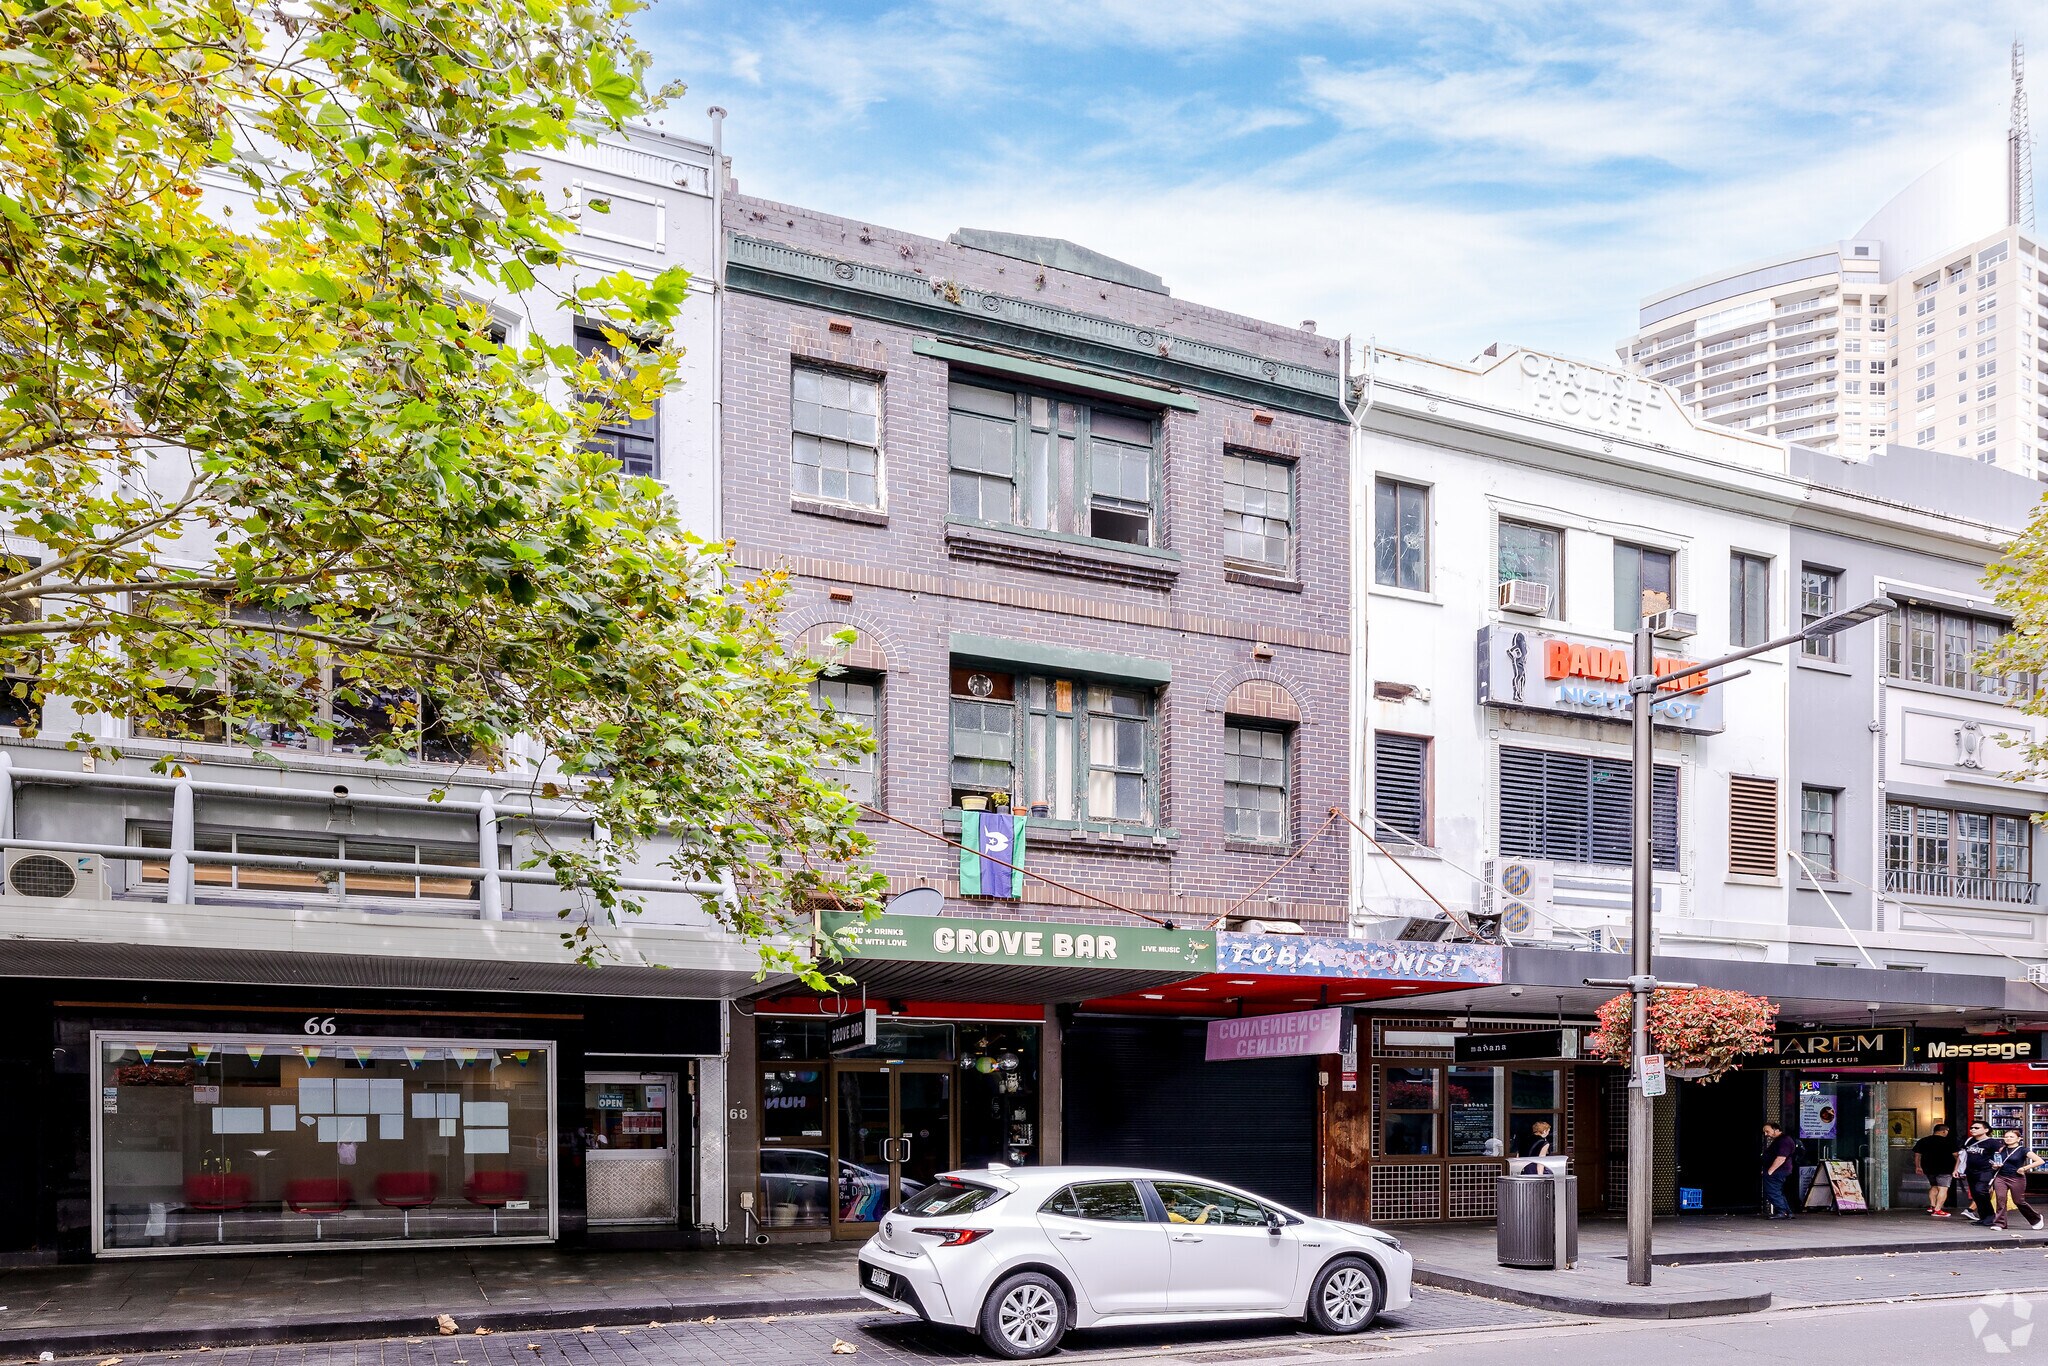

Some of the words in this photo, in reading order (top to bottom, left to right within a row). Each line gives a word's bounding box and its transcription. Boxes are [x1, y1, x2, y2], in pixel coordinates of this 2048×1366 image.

[1520, 354, 1662, 410] CARLISLE
[1544, 639, 1629, 683] BADA
[874, 928, 904, 936] DRINKS
[864, 938, 885, 946] WITH
[887, 939, 908, 947] LOVE
[933, 927, 1044, 956] GROVE
[1052, 933, 1118, 960] BAR
[304, 1016, 337, 1035] 66
[832, 1025, 850, 1044] GROVE
[851, 1021, 863, 1038] BAR
[1928, 1041, 2032, 1060] Massage
[1780, 1057, 1834, 1065] GENTLEMENS
[599, 1098, 623, 1108] OPEN
[729, 1108, 748, 1119] 68
